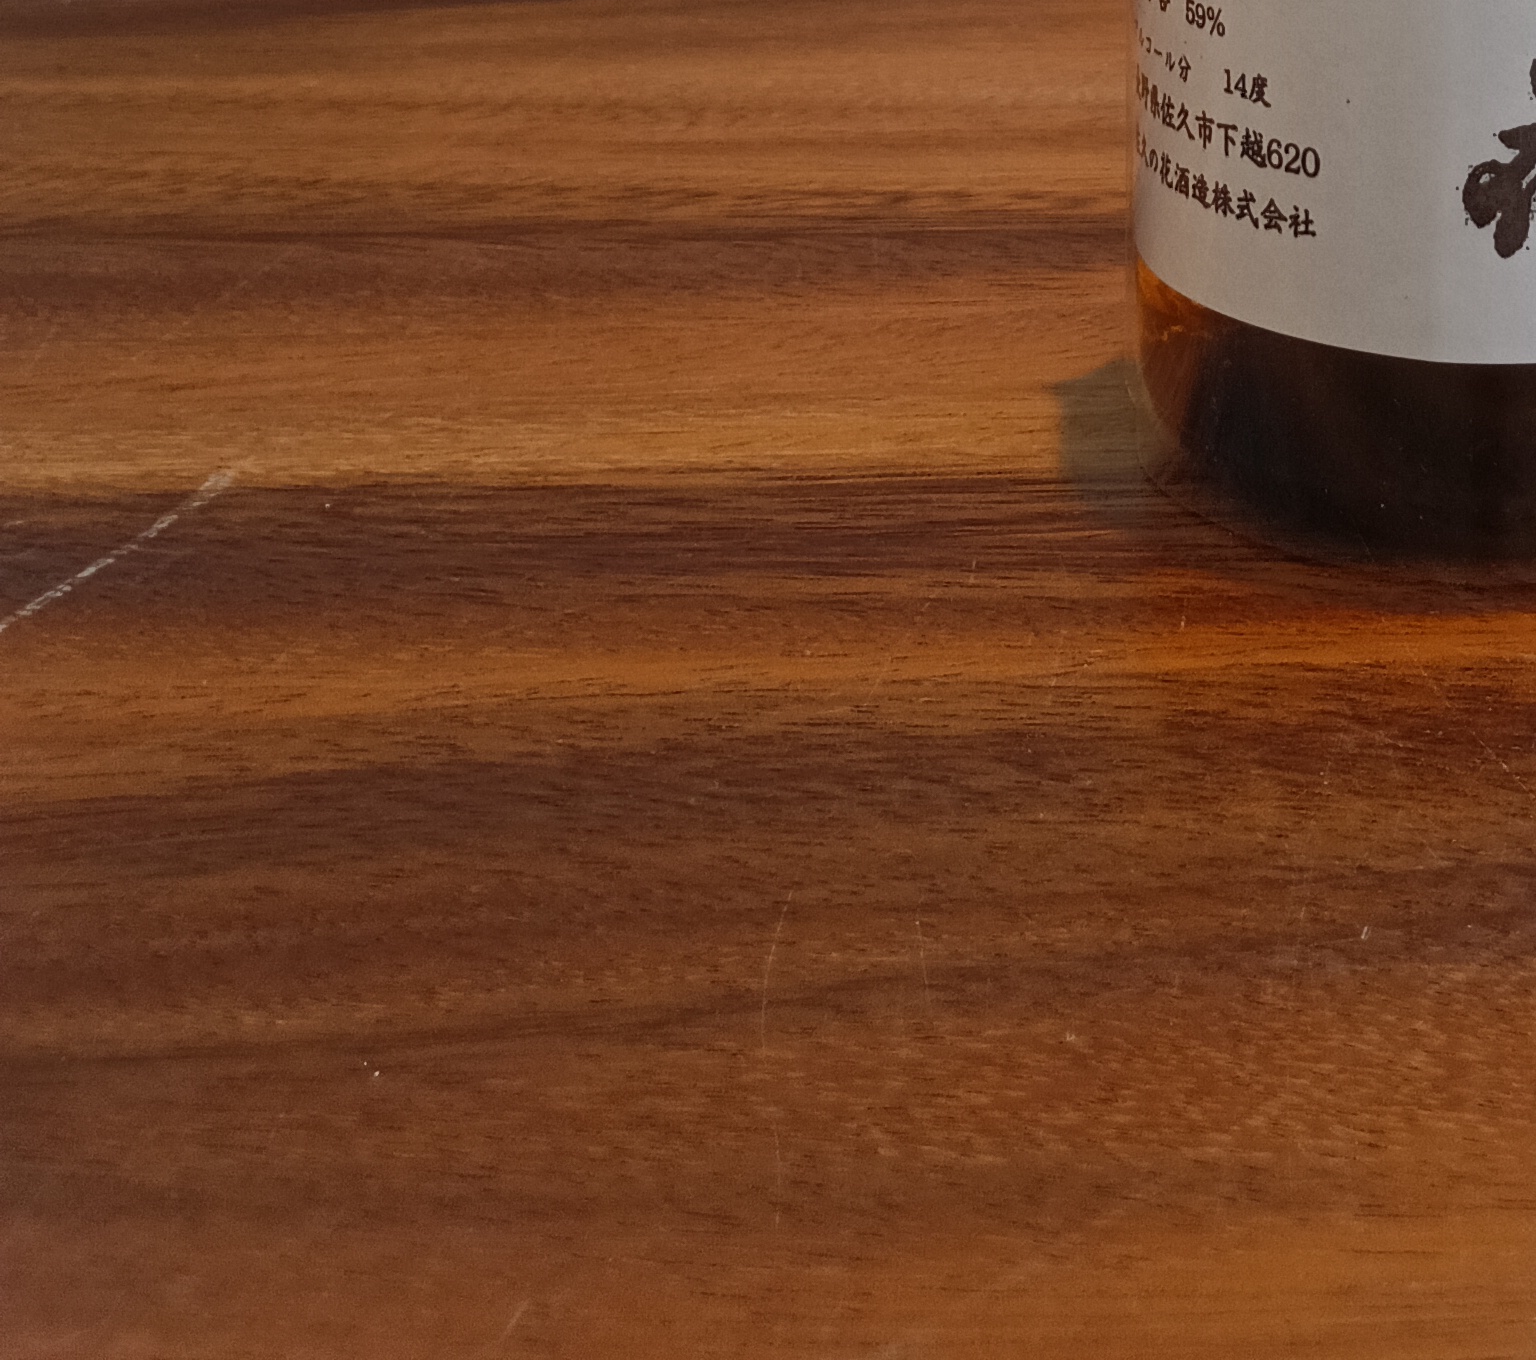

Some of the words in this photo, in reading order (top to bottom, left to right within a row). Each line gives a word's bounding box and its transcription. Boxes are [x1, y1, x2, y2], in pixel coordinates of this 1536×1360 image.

[1135, 19, 1192, 83] ルコール分
[1223, 68, 1272, 108] 14度
